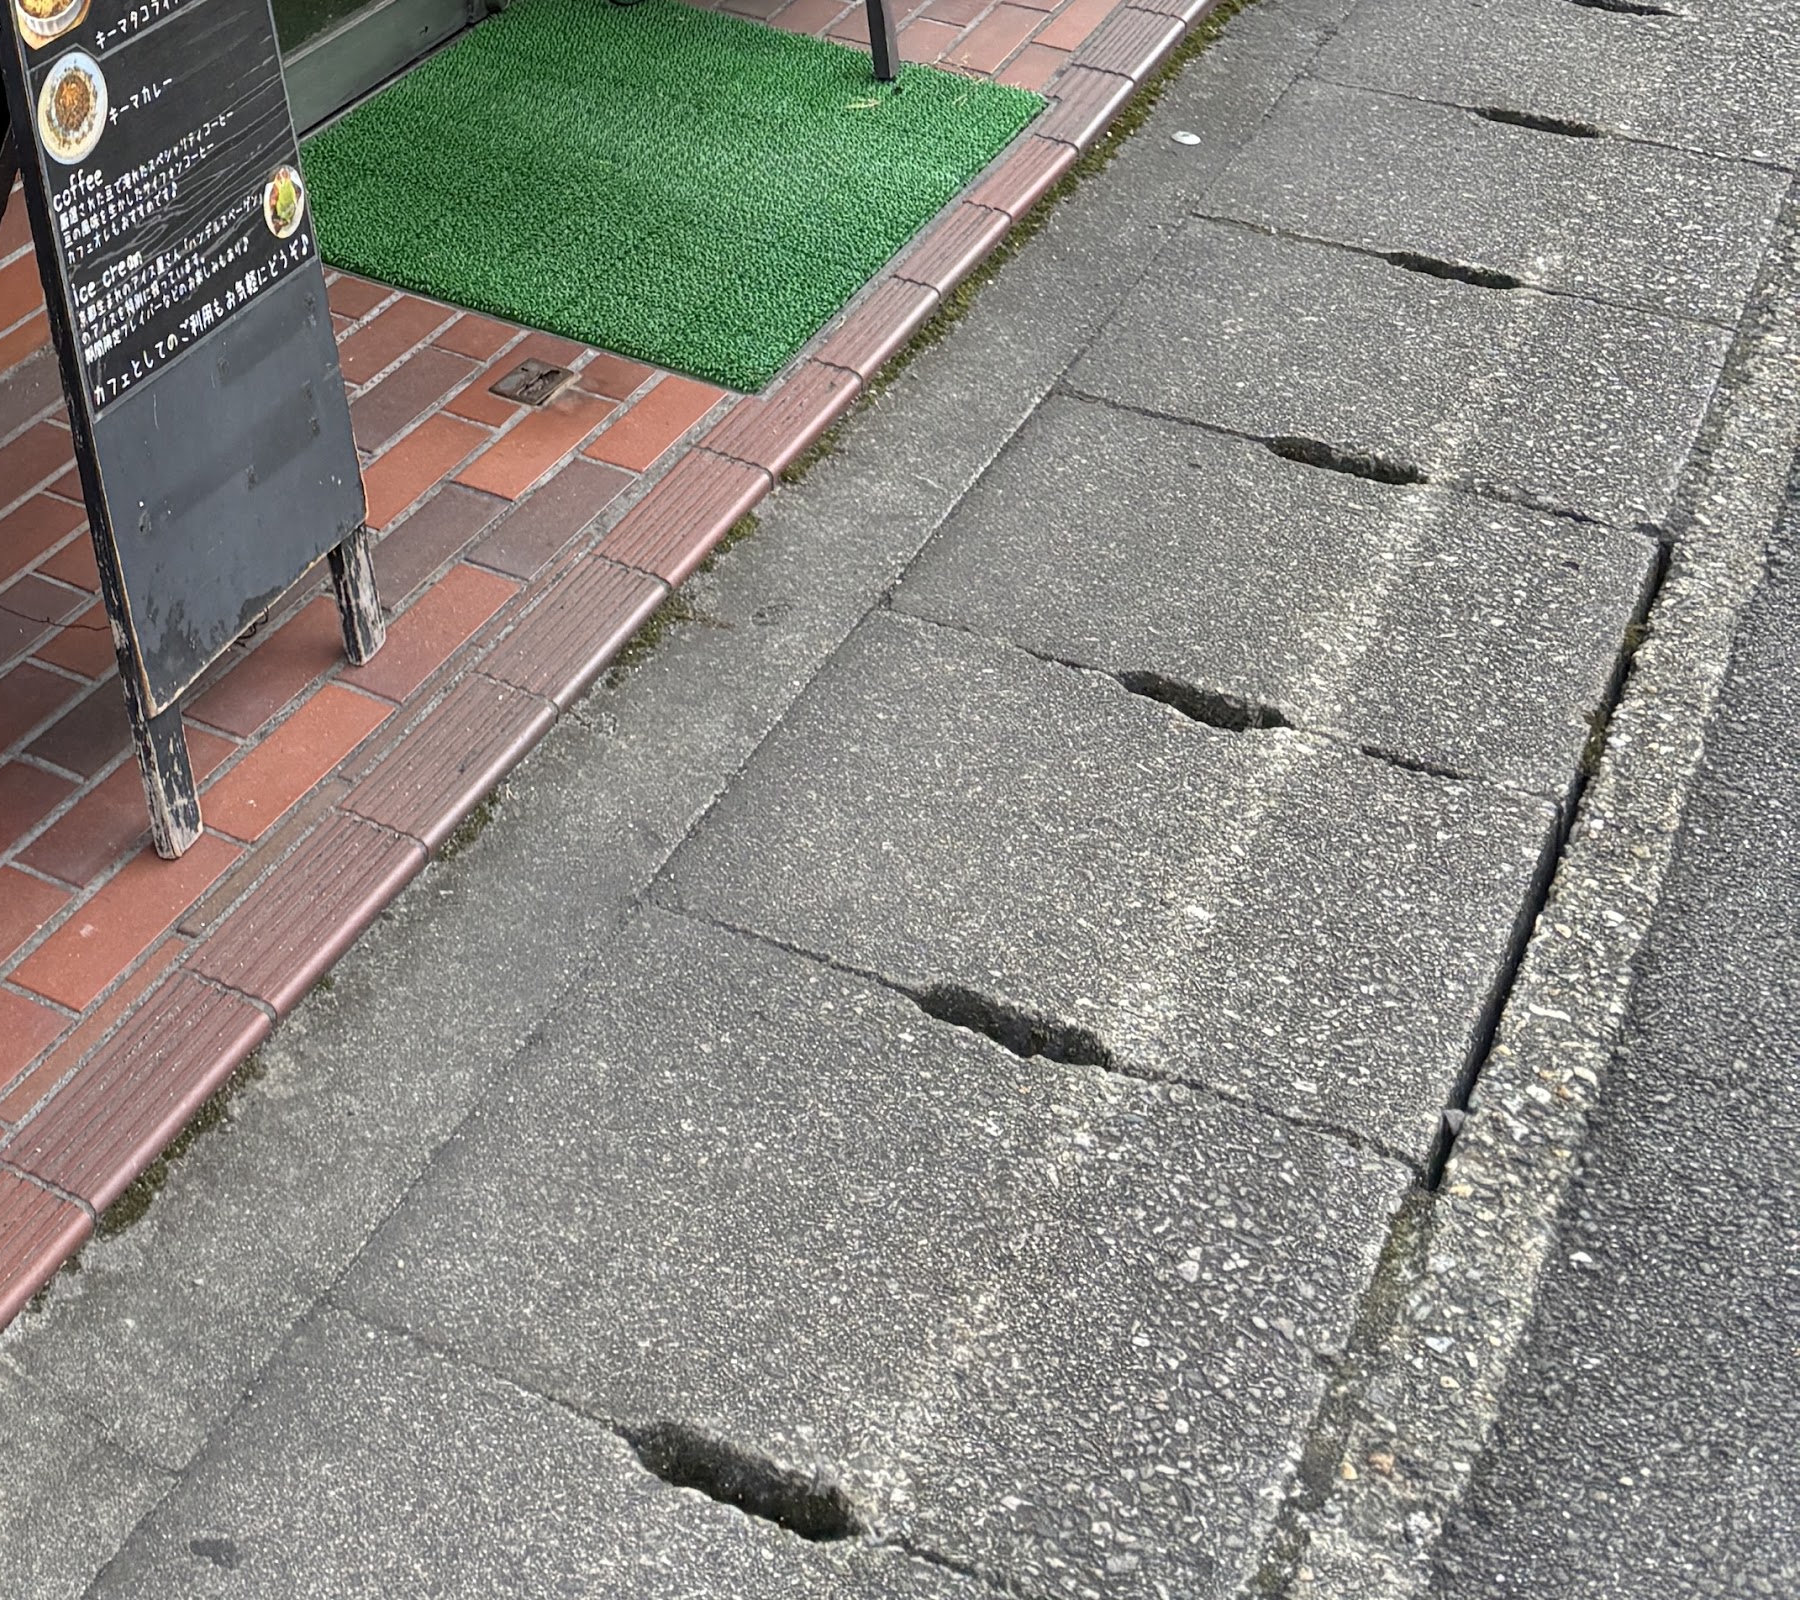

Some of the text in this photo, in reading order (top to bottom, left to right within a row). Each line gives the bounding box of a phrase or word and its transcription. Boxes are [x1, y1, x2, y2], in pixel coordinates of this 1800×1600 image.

[109, 77, 173, 125] キーマカレー
[53, 169, 103, 212] coffee
[71, 250, 144, 308] ice cream
